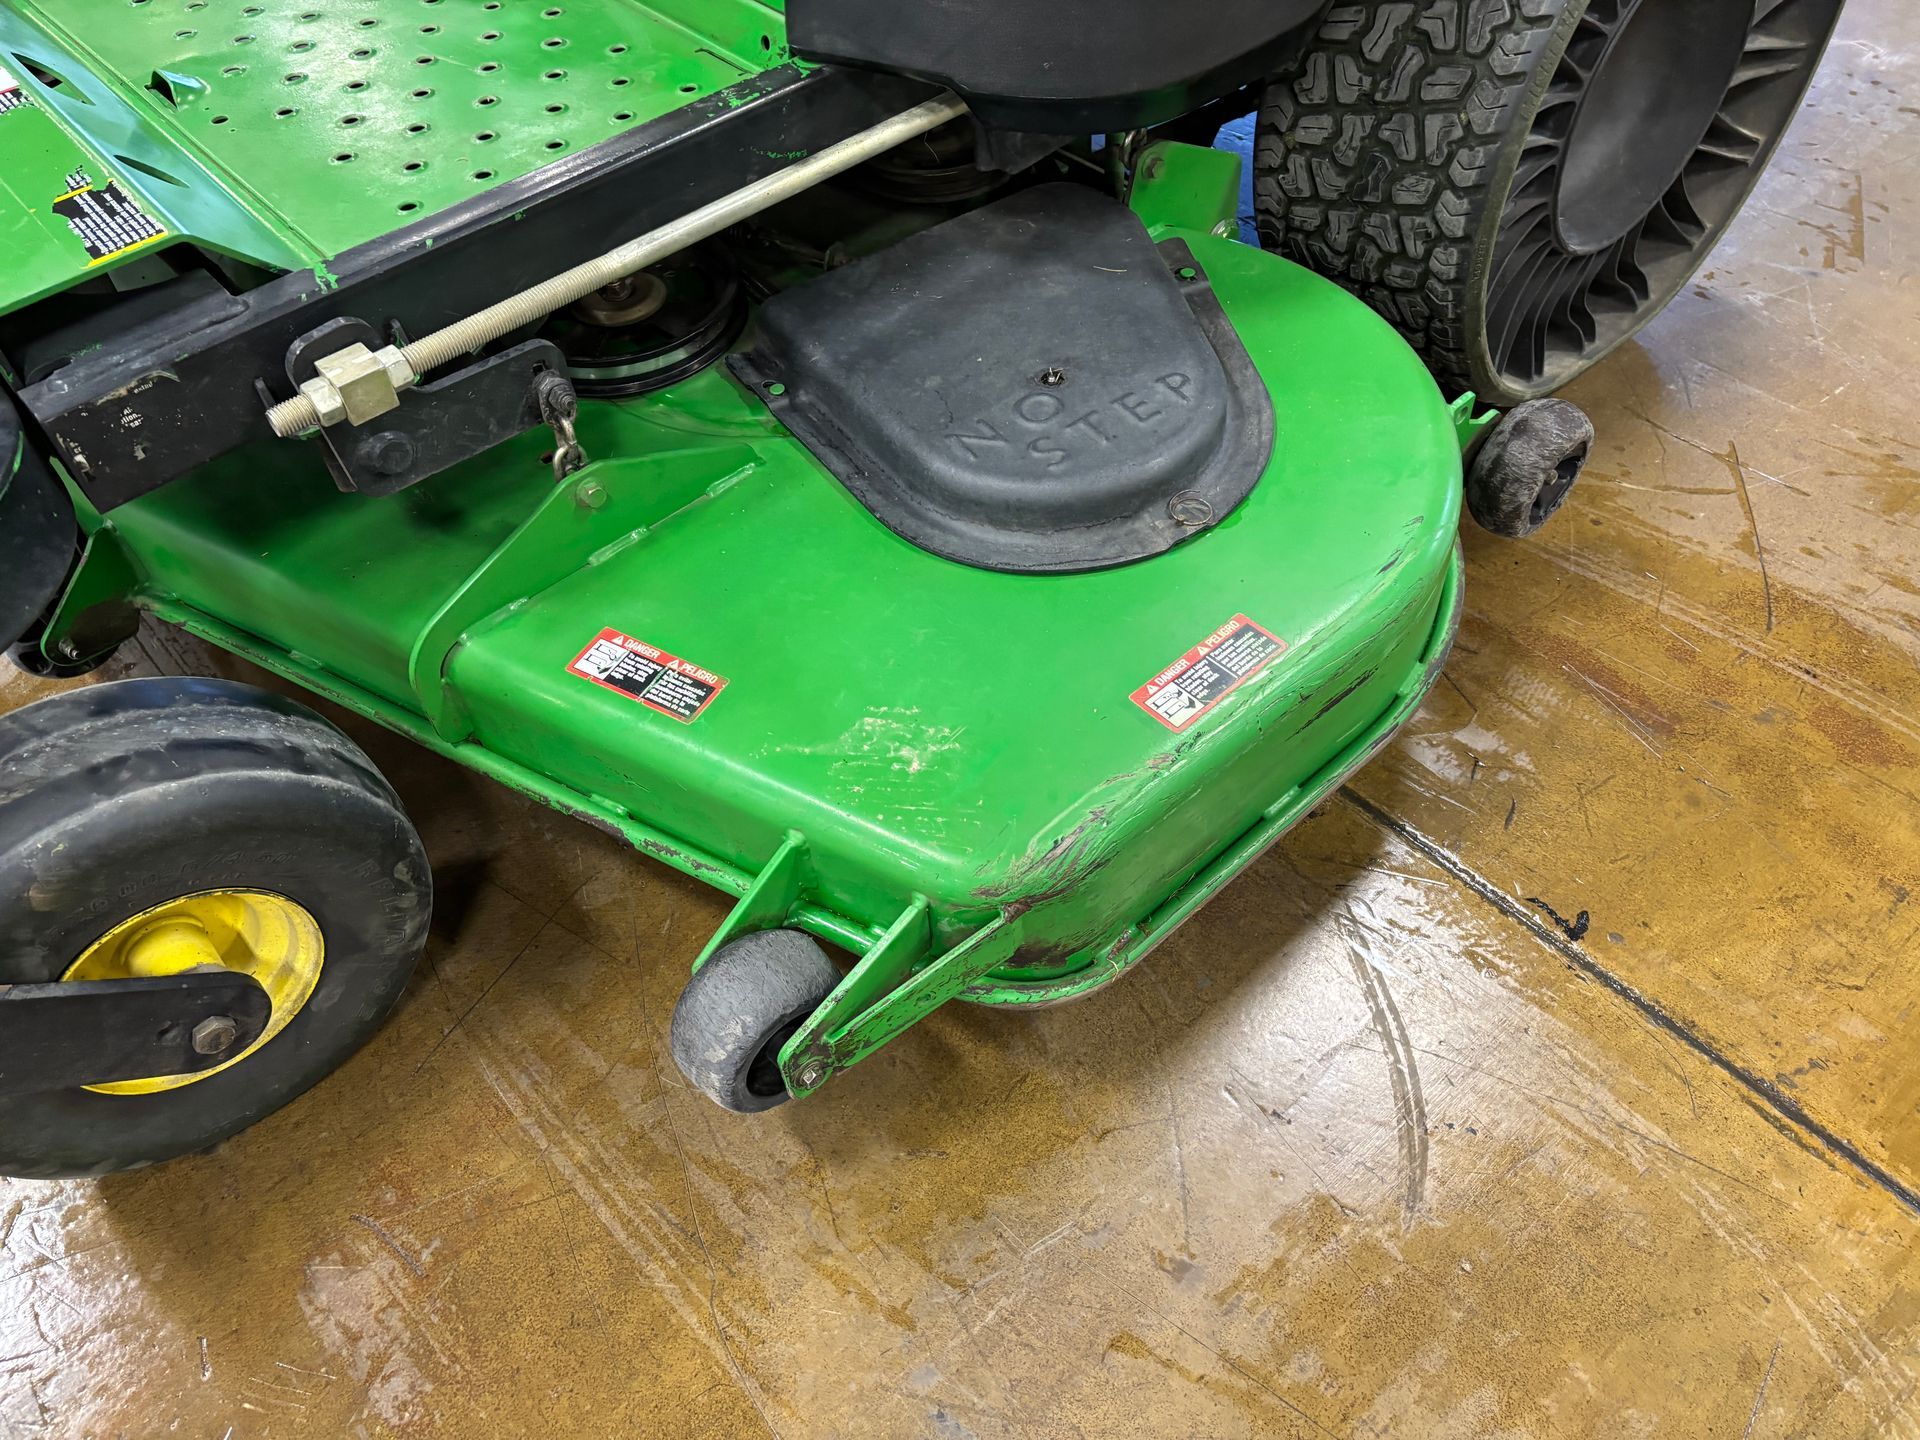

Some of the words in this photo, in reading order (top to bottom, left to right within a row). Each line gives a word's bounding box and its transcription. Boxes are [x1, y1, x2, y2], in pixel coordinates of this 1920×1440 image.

[944, 392, 1065, 462] NO
[1027, 372, 1193, 468] STEP
[1206, 620, 1241, 647] PELIGRO
[624, 639, 661, 659] DANGER
[680, 664, 718, 684] PELIGRO
[1154, 658, 1191, 687] DANGER
